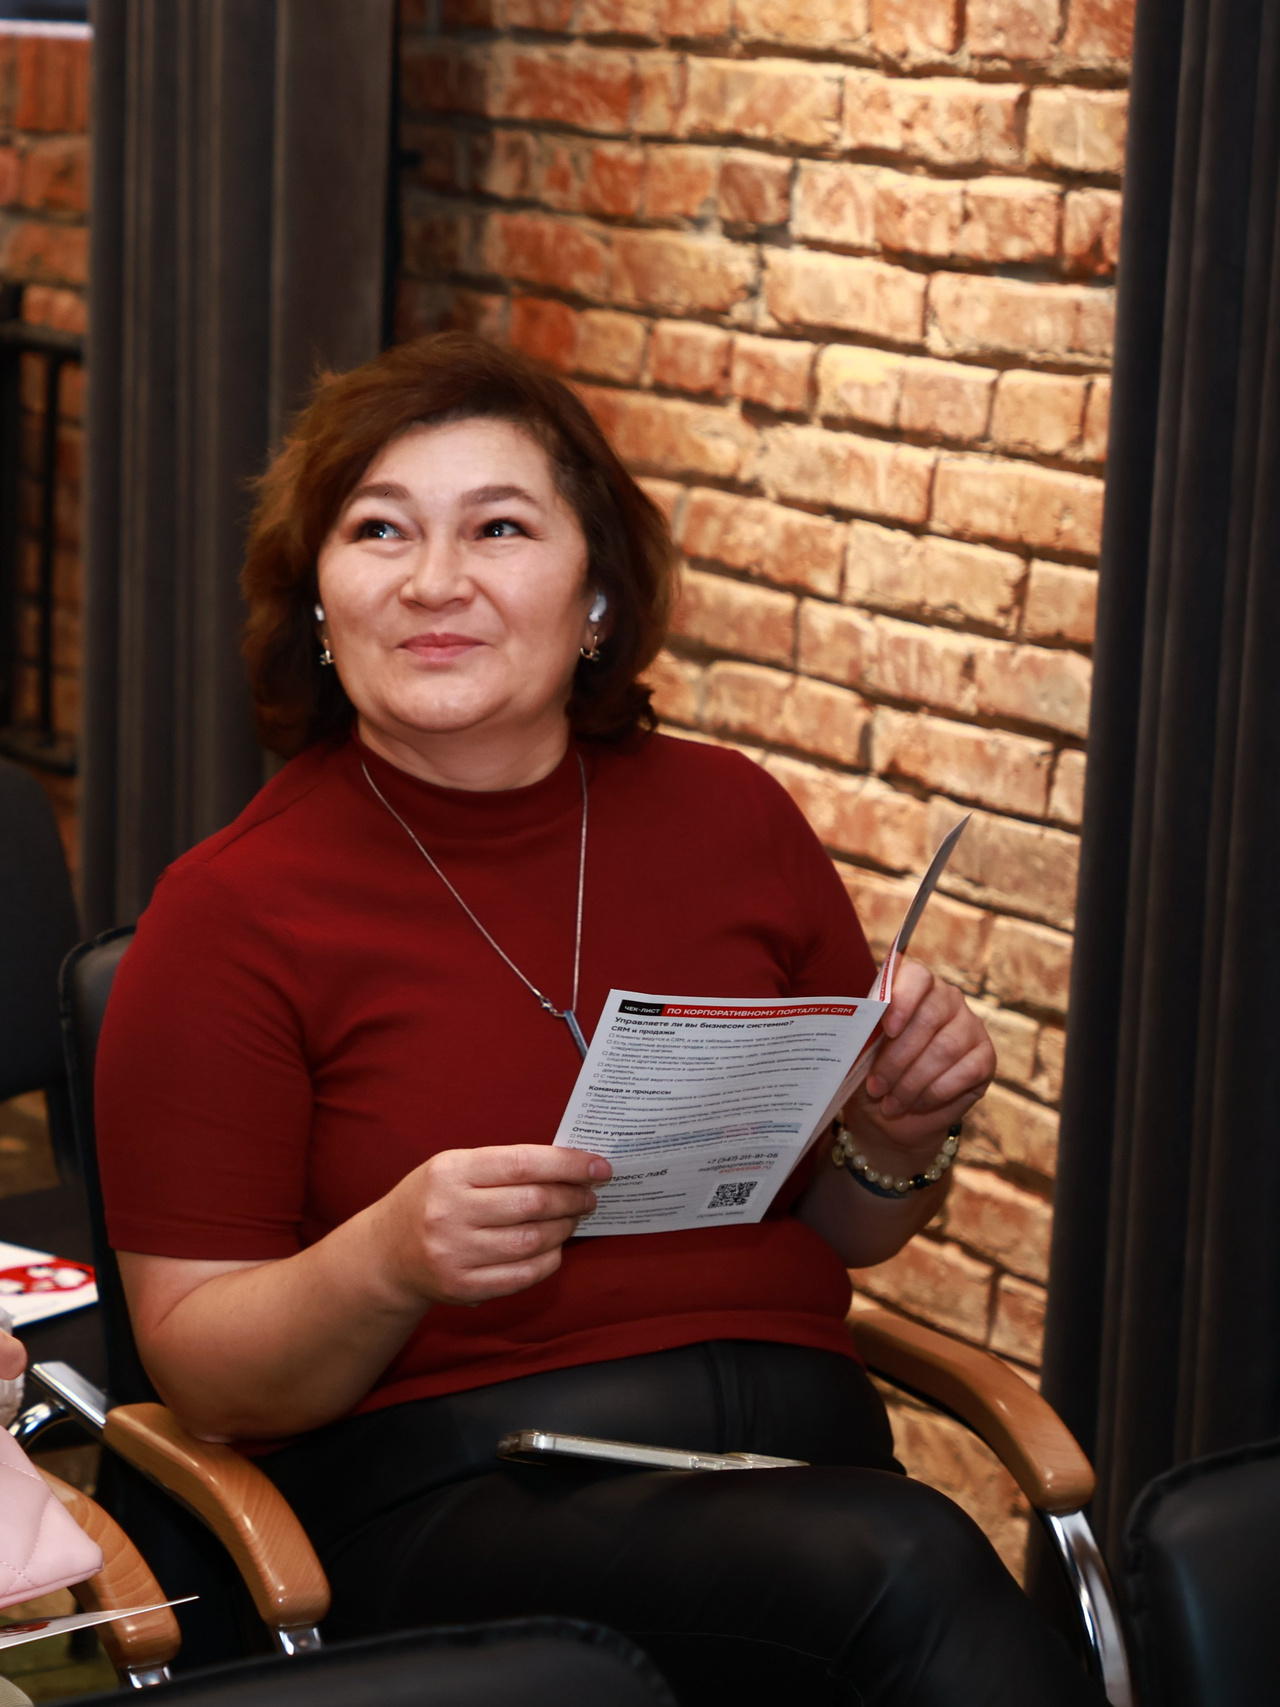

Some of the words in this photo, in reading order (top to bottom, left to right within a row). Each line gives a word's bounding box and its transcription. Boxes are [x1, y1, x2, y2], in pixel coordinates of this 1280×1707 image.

[624, 1005, 661, 1014] ЧЕК-ЛИСТ
[683, 1008, 776, 1017] КОРПОРАТИВНОМУ
[776, 1007, 821, 1016] ПОРТАЛУ
[614, 1016, 670, 1027] Управляете
[746, 1020, 795, 1029] системно?
[588, 1085, 624, 1093] Команда
[572, 1126, 602, 1134] Отчеты
[609, 1172, 645, 1182] пресс
[645, 1168, 669, 1178] лаб
